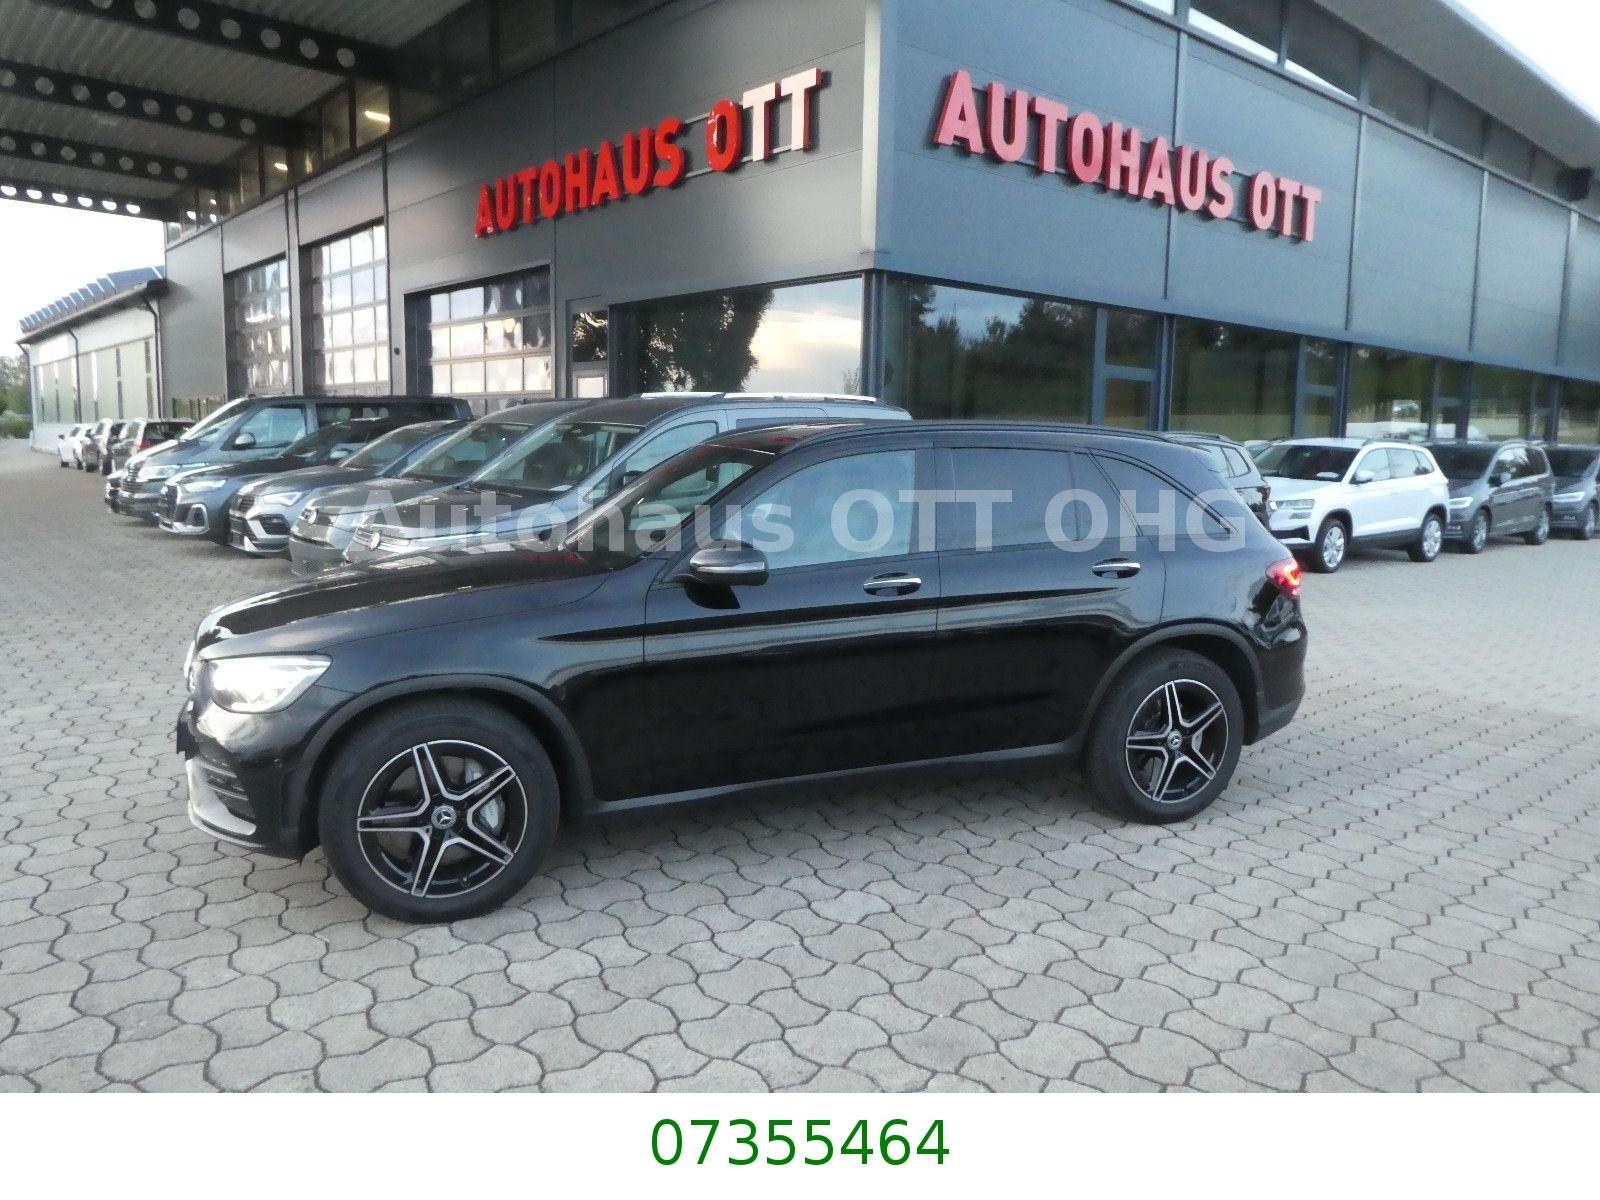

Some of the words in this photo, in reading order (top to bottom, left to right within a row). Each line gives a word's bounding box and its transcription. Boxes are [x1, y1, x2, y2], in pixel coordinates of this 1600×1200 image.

[475, 117, 686, 238] AUTOHAUS
[706, 67, 822, 172] OTT
[933, 69, 1236, 219] AUTOHAUS
[1249, 170, 1322, 242] OTT
